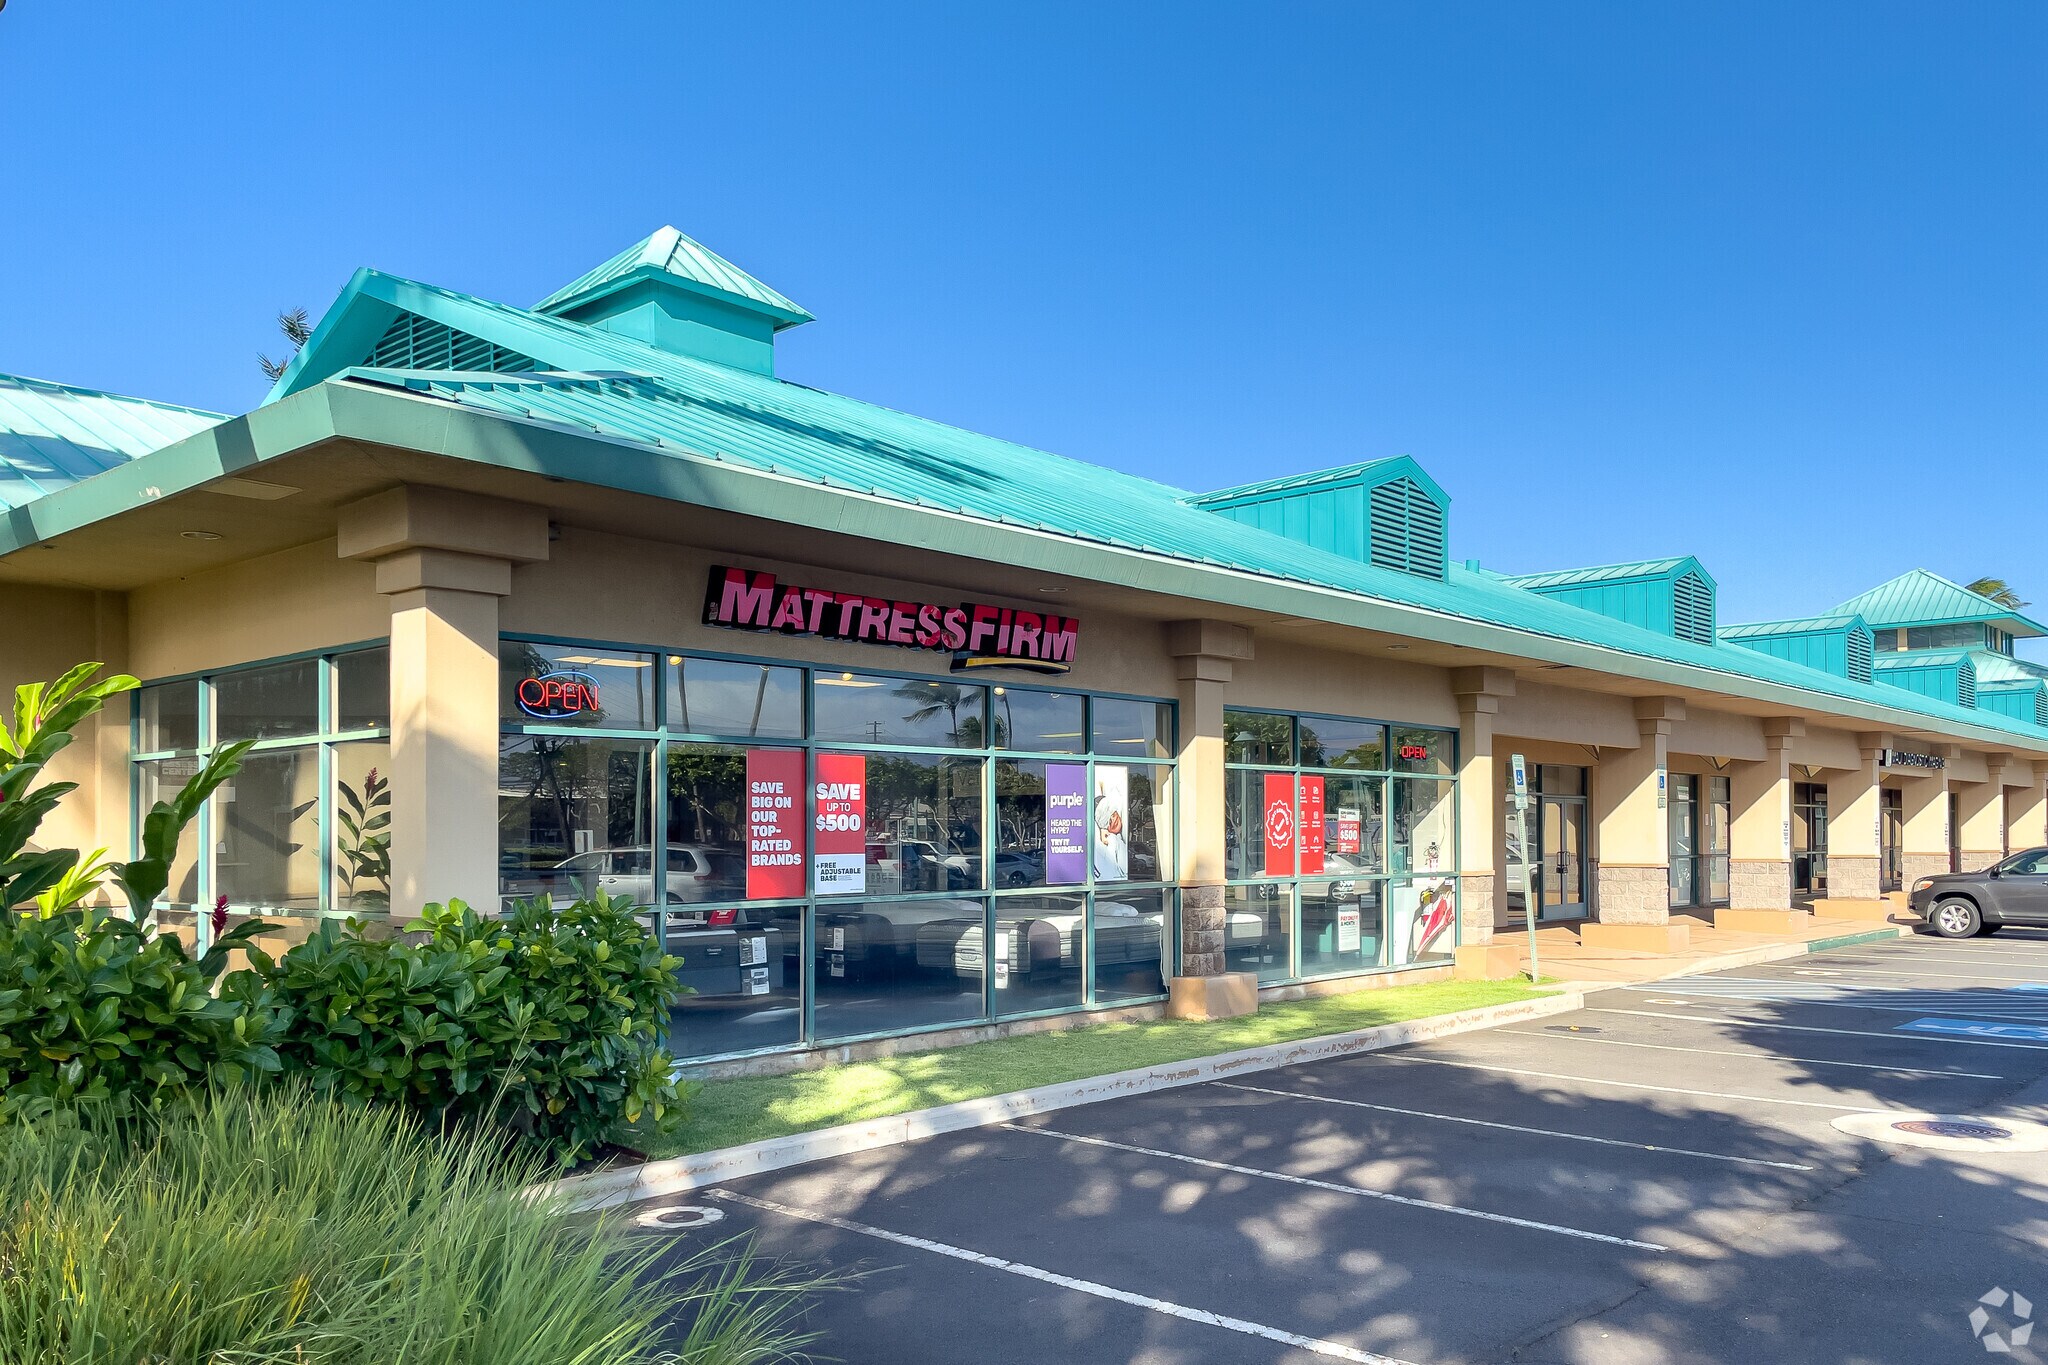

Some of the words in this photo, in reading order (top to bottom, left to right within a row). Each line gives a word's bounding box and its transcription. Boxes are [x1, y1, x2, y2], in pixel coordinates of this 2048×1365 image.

[717, 566, 967, 649] MATTRESS
[969, 604, 1080, 662] FIRM
[519, 677, 599, 712] OPEN
[1401, 745, 1427, 759] OPEN
[751, 782, 784, 794] SAVE
[816, 783, 861, 800] SAVE
[751, 796, 774, 808] BIG
[775, 796, 792, 808] ON
[1050, 792, 1083, 808] purple
[826, 802, 838, 812] UP
[841, 802, 851, 812] TO
[751, 810, 777, 823] OUR
[816, 814, 861, 832] $500
[1050, 819, 1071, 827] HEARD
[1071, 819, 1082, 827] THE
[751, 825, 782, 837] TOP-
[1340, 829, 1358, 841] $500
[751, 840, 792, 851] RATED
[751, 854, 802, 866] BRANDS
